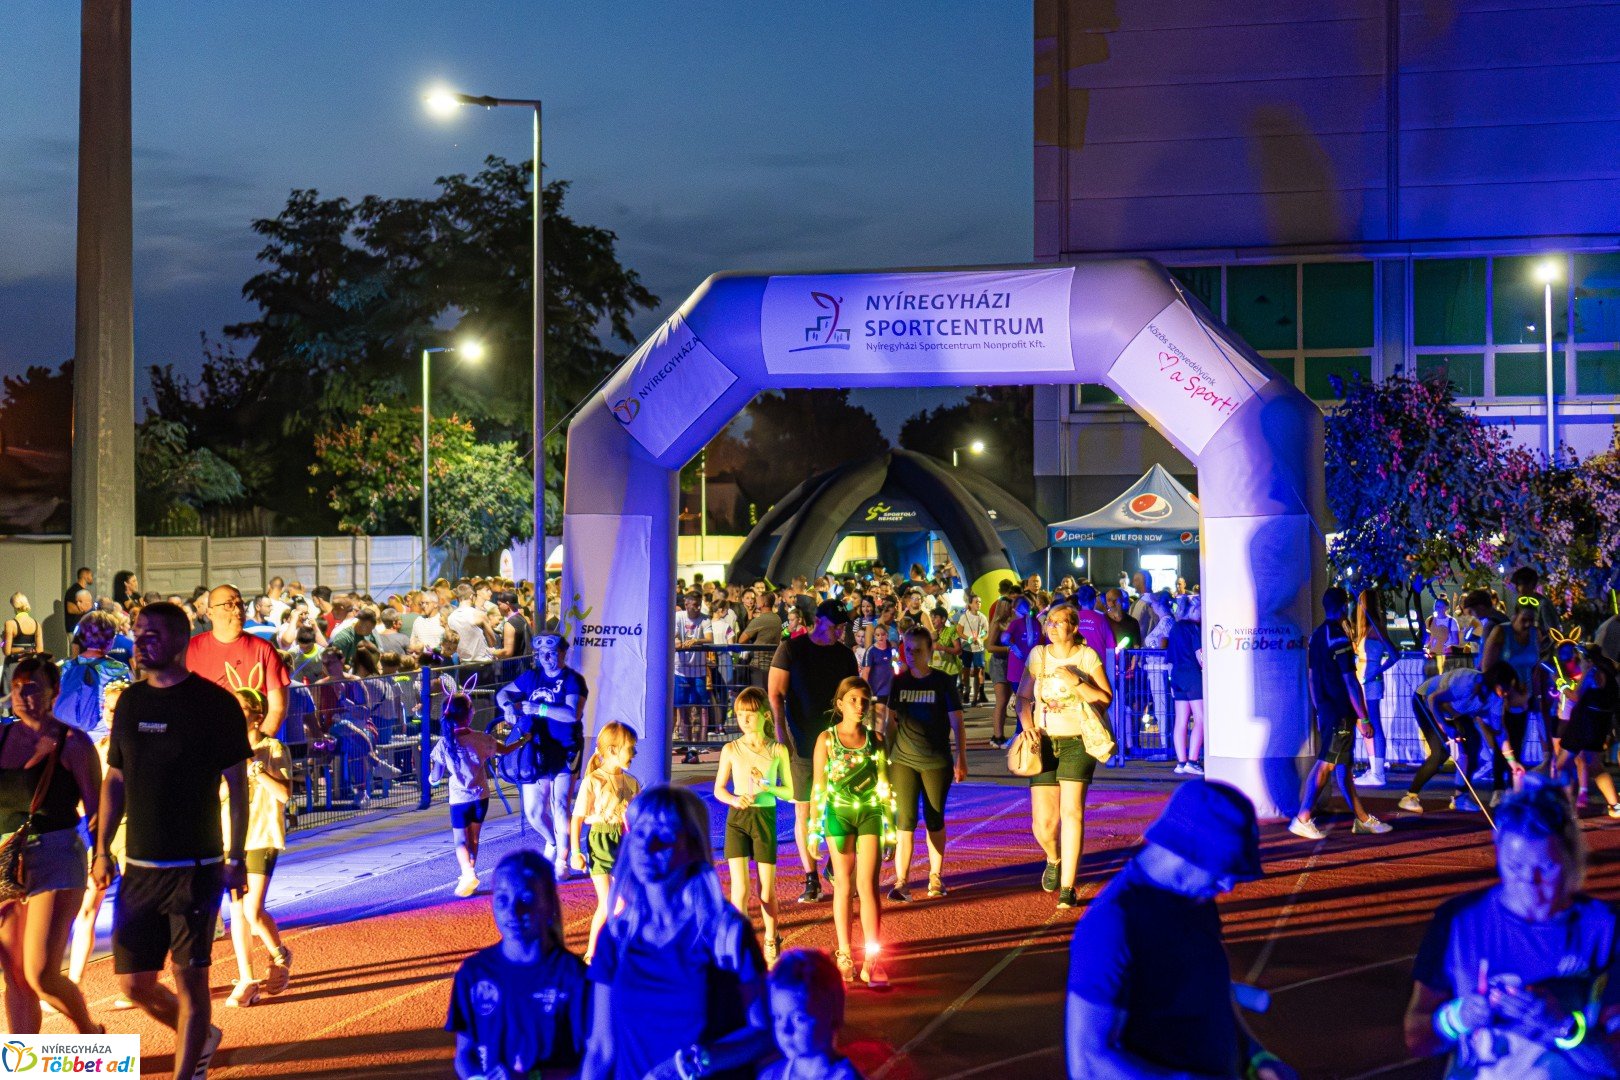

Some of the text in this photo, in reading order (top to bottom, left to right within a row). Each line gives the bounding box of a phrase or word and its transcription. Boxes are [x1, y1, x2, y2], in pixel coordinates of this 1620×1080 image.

[866, 289, 1011, 311] NYÍREGYHÁZI
[864, 317, 1044, 337] SPORTCENTRUM
[866, 340, 1046, 353] Nyíregyházi Sportcentrum Nonprofit Kft.
[1147, 323, 1217, 387] Közös szenvedélyünk
[638, 336, 700, 400] NYÍREGYHÁZA
[1170, 371, 1239, 415] a Sport!
[1068, 532, 1095, 542] pepsi
[1144, 534, 1163, 542] NOW
[581, 623, 643, 636] SPORTOLÓ
[573, 636, 617, 648] NEMZET
[1235, 636, 1284, 651] Többet
[552, 679, 564, 694] 3
[899, 689, 936, 703] PUMA
